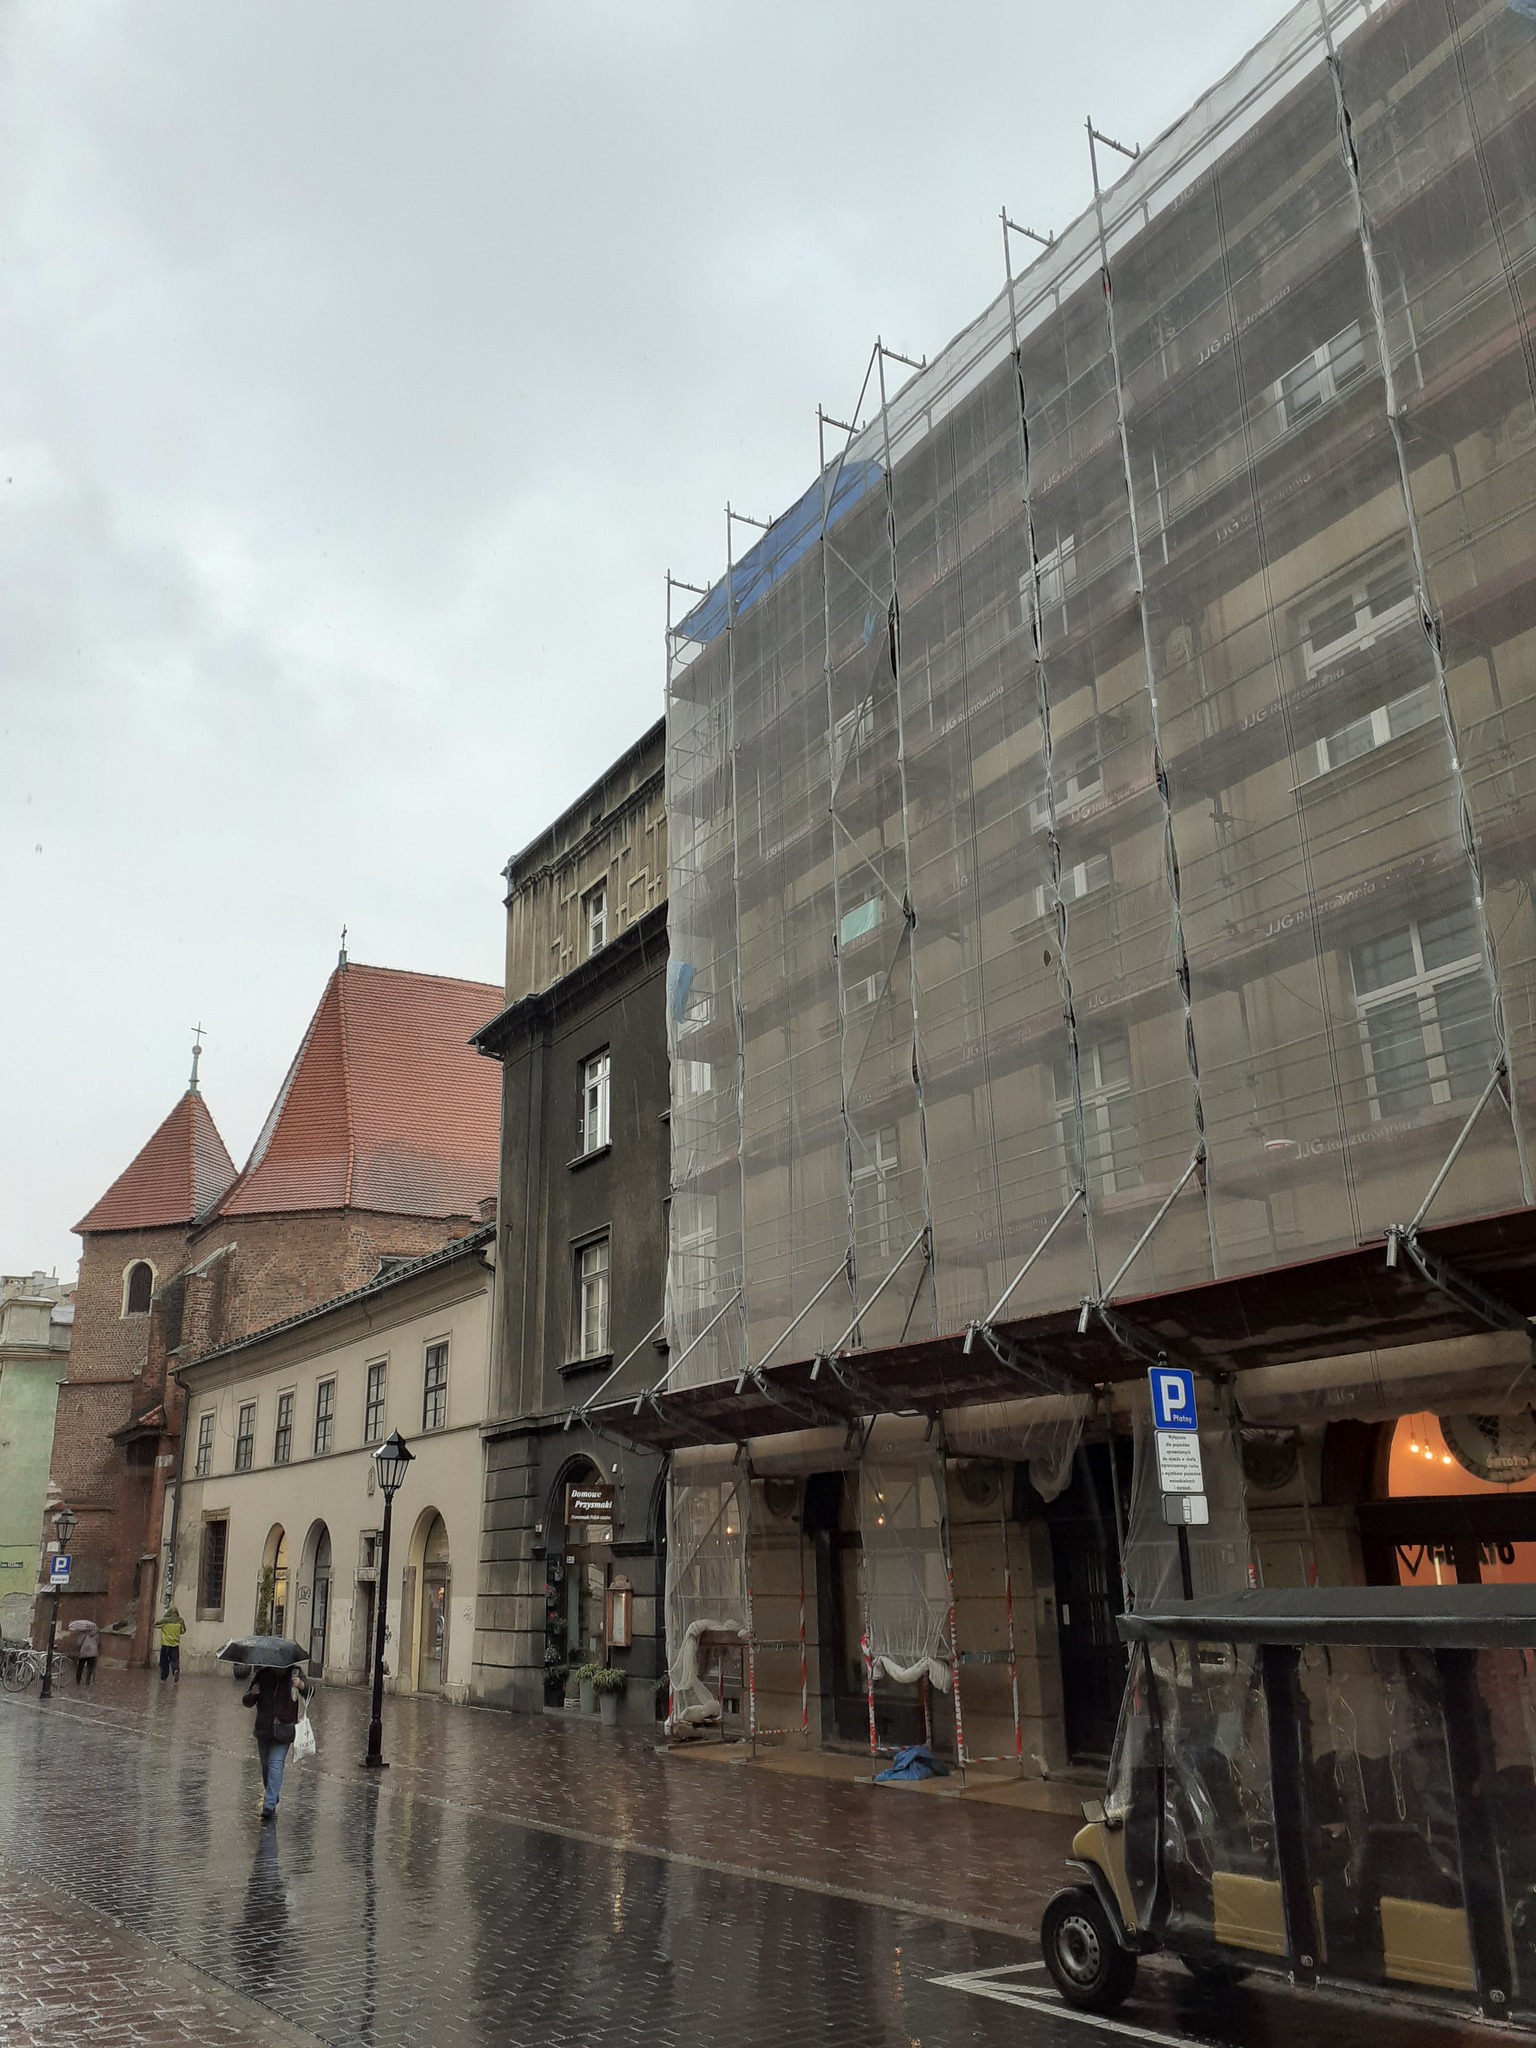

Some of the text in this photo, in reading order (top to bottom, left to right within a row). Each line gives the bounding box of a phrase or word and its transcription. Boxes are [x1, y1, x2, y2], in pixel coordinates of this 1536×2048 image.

[1198, 339, 1221, 365] JJG
[1041, 473, 1060, 493] JJG
[940, 719, 957, 736] JJG
[1242, 708, 1267, 731] JJG
[1266, 913, 1293, 937] JJG
[1160, 1375, 1186, 1422] P
[1172, 1413, 1193, 1425] Płatny
[571, 1490, 602, 1498] Domowe
[574, 1500, 613, 1510] Przysmaki
[55, 1557, 67, 1572] P
